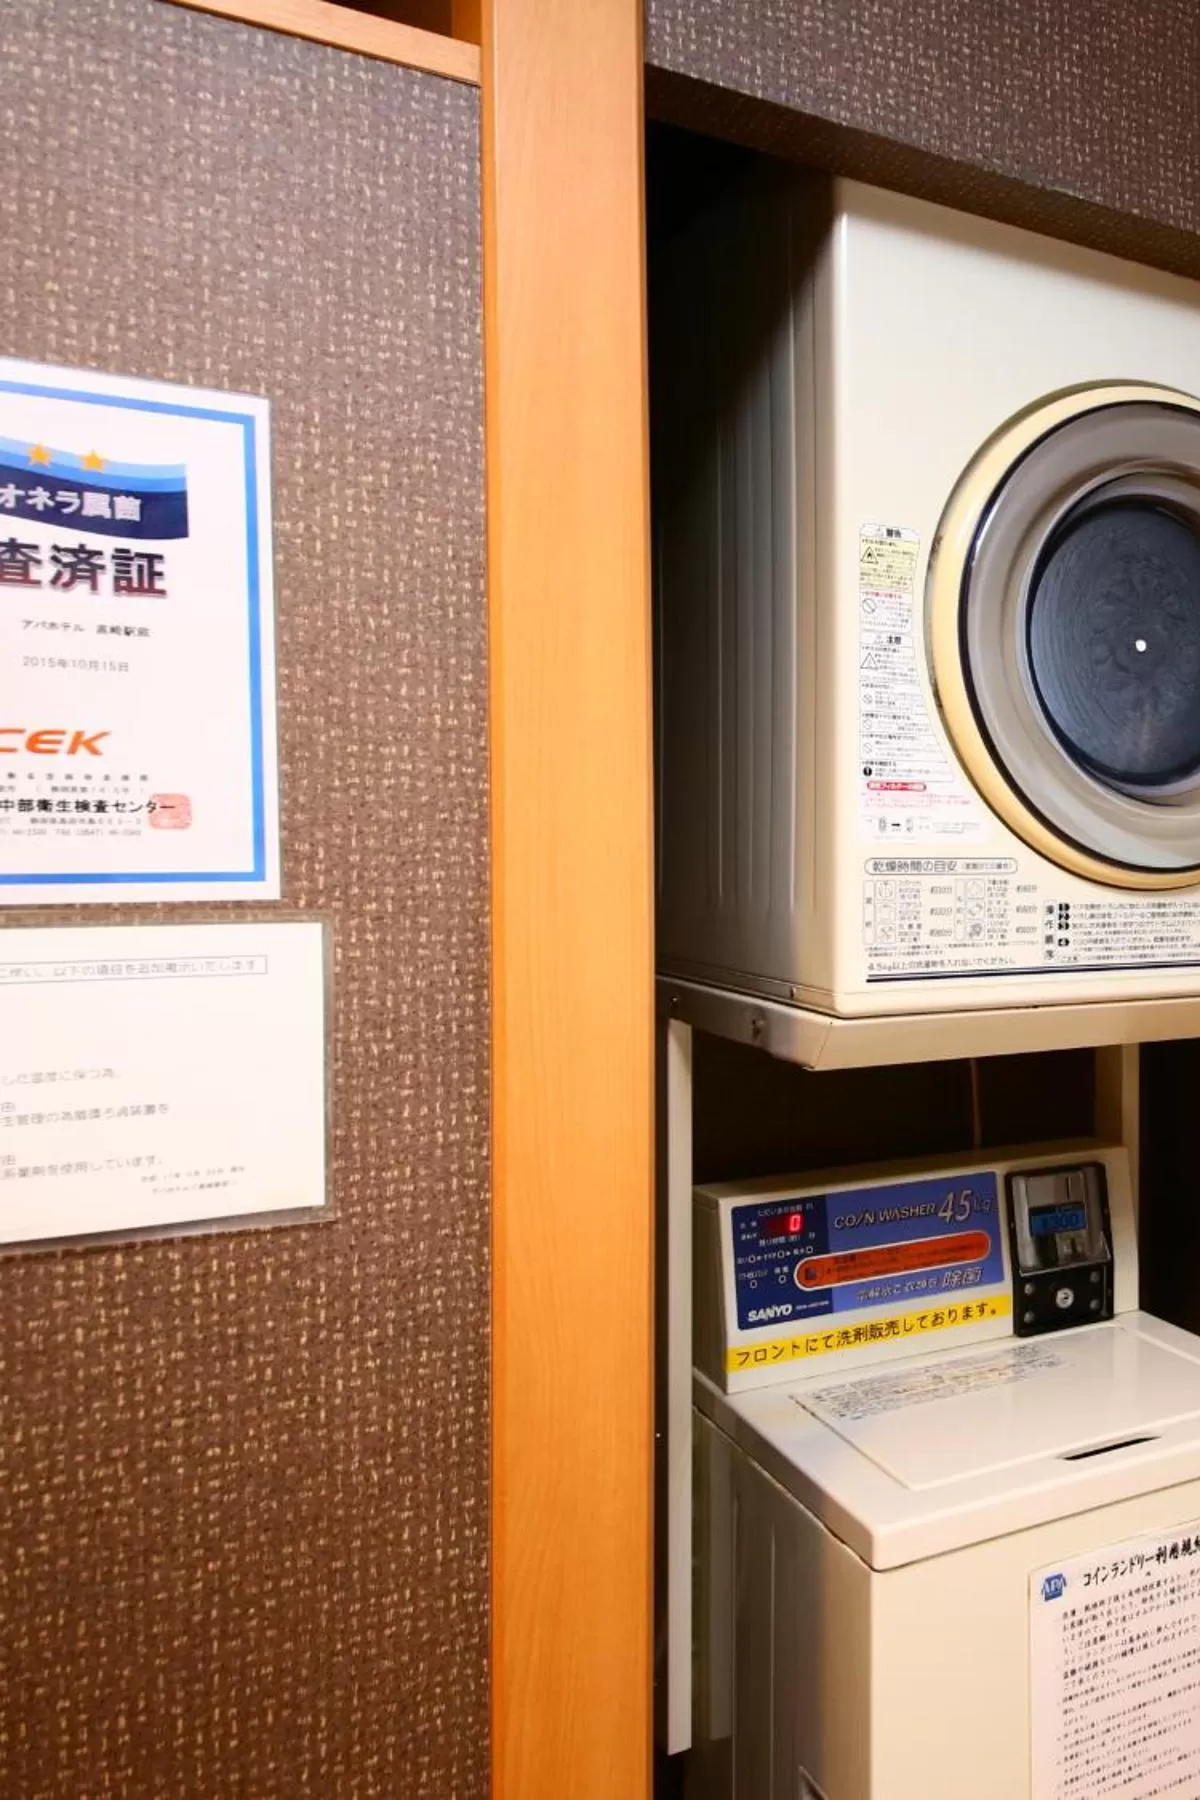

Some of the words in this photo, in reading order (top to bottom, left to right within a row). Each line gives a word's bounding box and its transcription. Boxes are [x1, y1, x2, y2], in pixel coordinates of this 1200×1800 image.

[0, 537, 167, 598] 査済証
[0, 798, 176, 815] 中部衛生検査センター
[872, 860, 958, 873] 乾燥時間の目安
[789, 1214, 801, 1232] 0
[834, 1212, 875, 1229] COIN
[880, 1202, 936, 1223] WASHER
[747, 1303, 792, 1322] SANYO
[736, 1299, 998, 1367] フロントにて洗剤販売しております。
